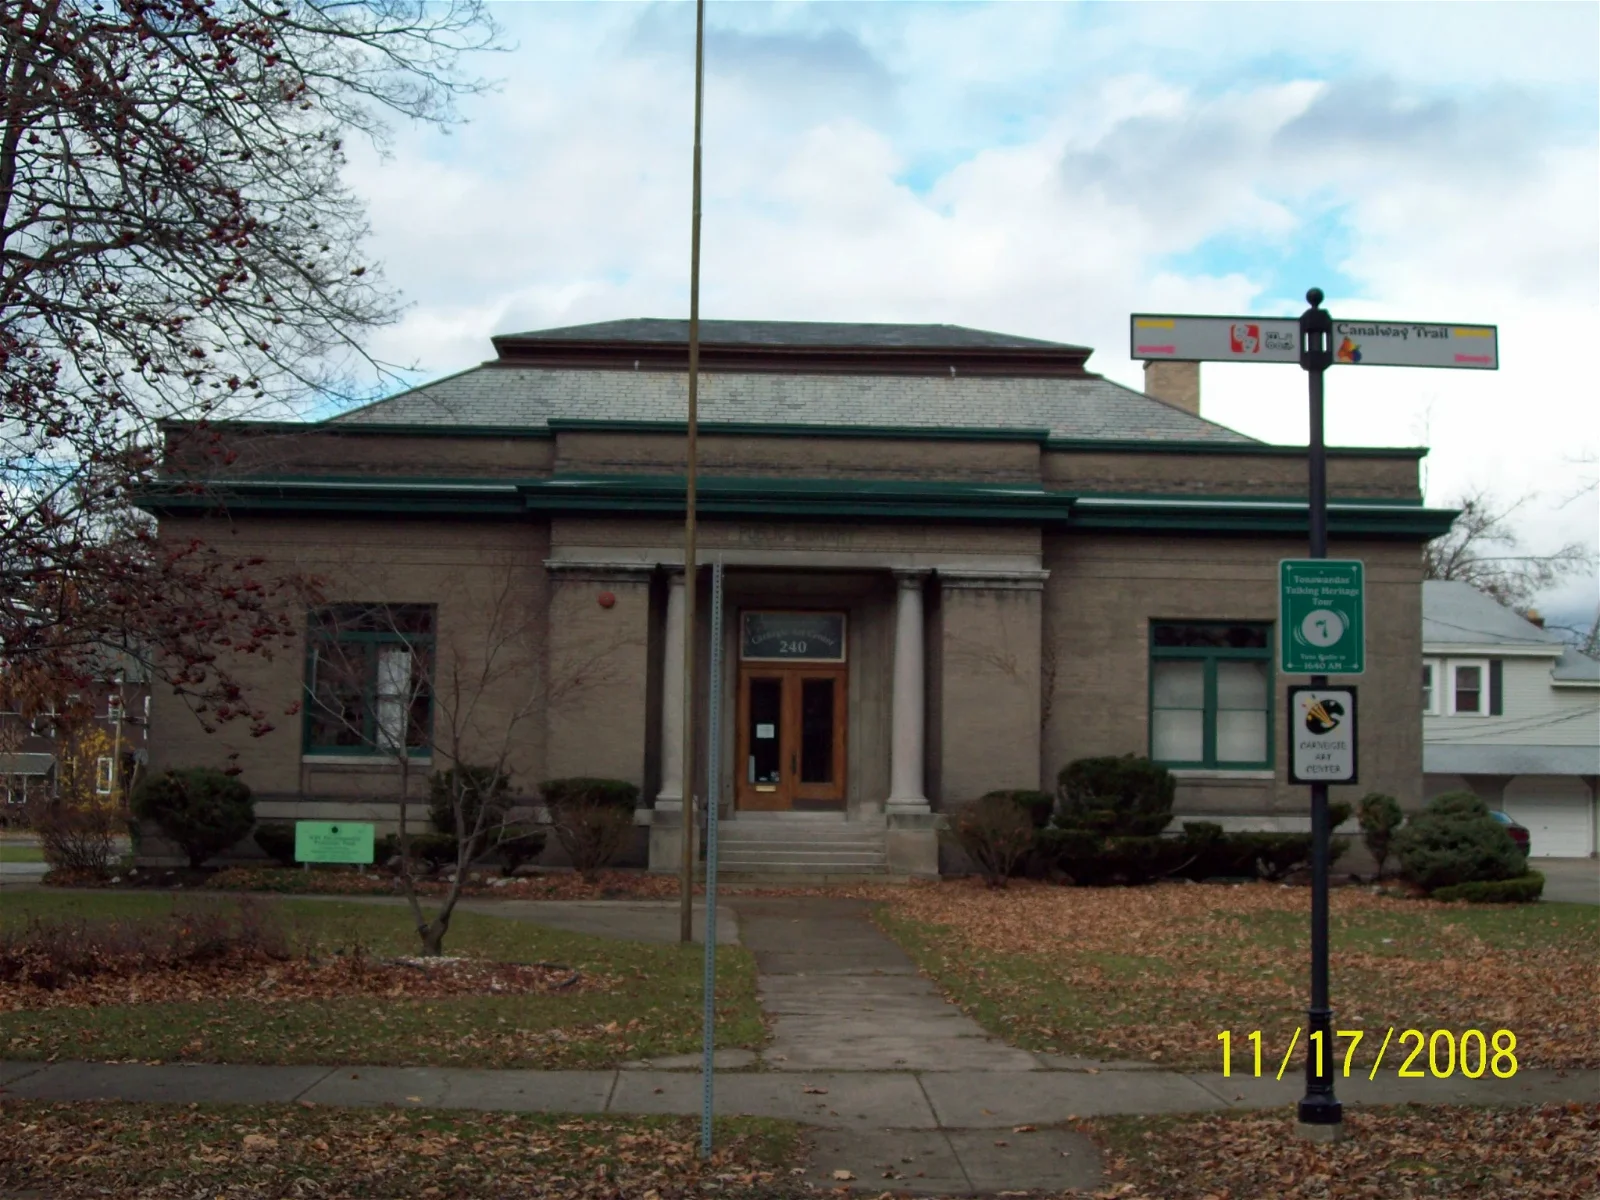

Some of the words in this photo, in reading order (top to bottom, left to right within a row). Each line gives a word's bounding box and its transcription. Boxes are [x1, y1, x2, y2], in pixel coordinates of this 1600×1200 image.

[1337, 323, 1409, 340] Canalway
[1412, 325, 1449, 339] Trail
[1285, 586, 1319, 596] Talking
[1321, 586, 1359, 597] Heritage
[1312, 597, 1334, 606] Tour
[1314, 619, 1328, 638] 7
[780, 640, 807, 653] 240
[1328, 661, 1342, 670] AM
[1299, 741, 1347, 750] CARNEGIE
[1314, 753, 1332, 761] ART
[1306, 764, 1342, 774] CENTER
